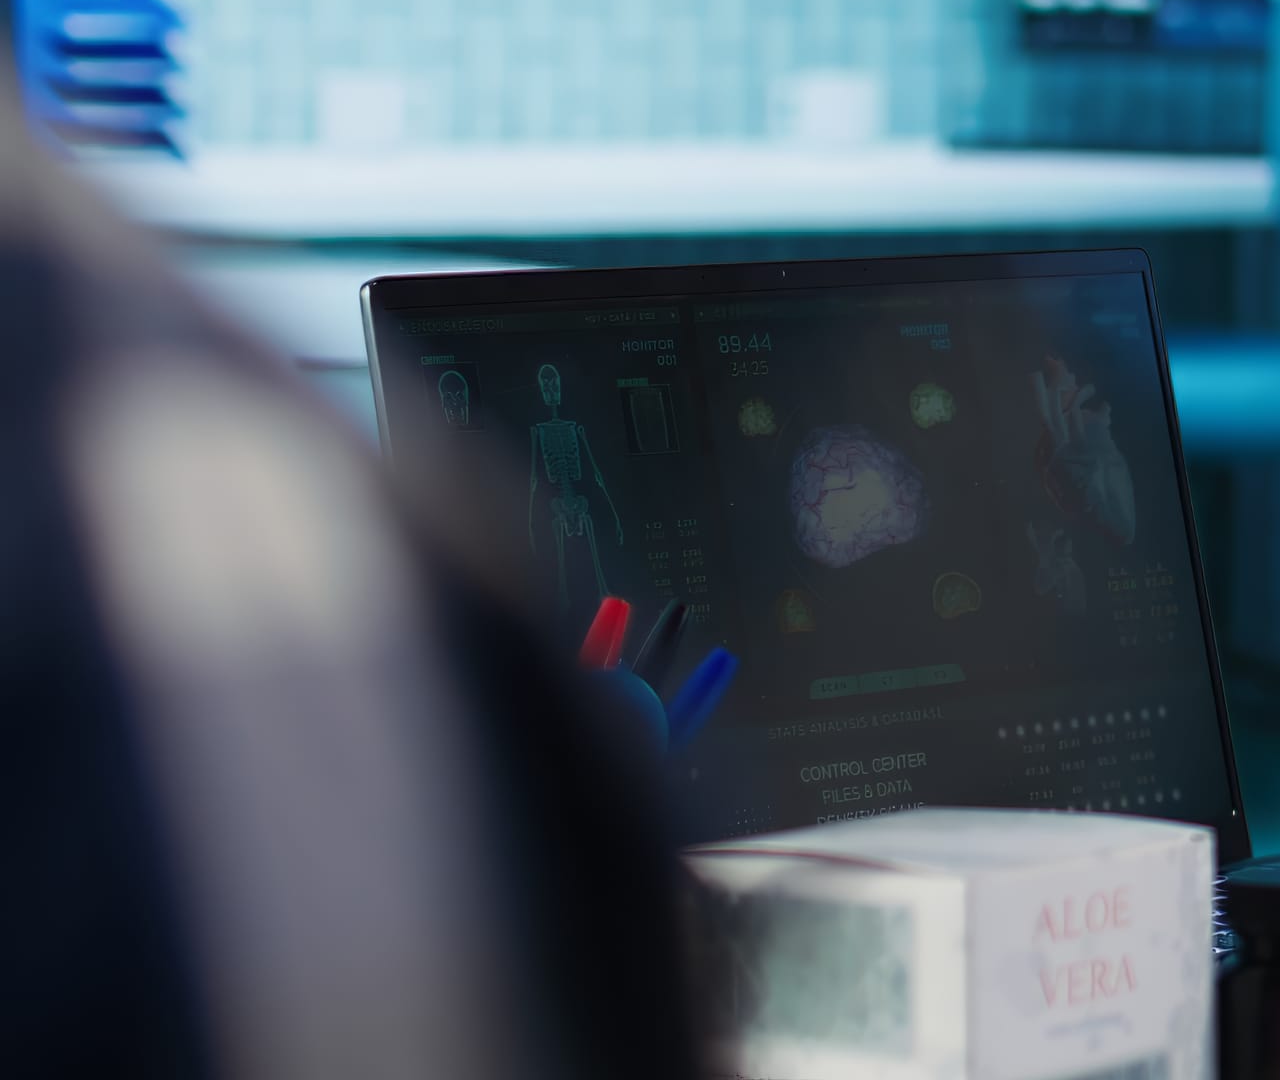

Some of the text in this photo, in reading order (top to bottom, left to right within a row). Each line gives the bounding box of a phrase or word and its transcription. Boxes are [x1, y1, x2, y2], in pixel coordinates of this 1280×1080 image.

[718, 332, 772, 354] 89.44
[800, 752, 928, 783] CONTROL CENTER
[876, 778, 913, 797] DATA
[1032, 885, 1133, 945] ALOE
[1037, 954, 1138, 1009] VERA
